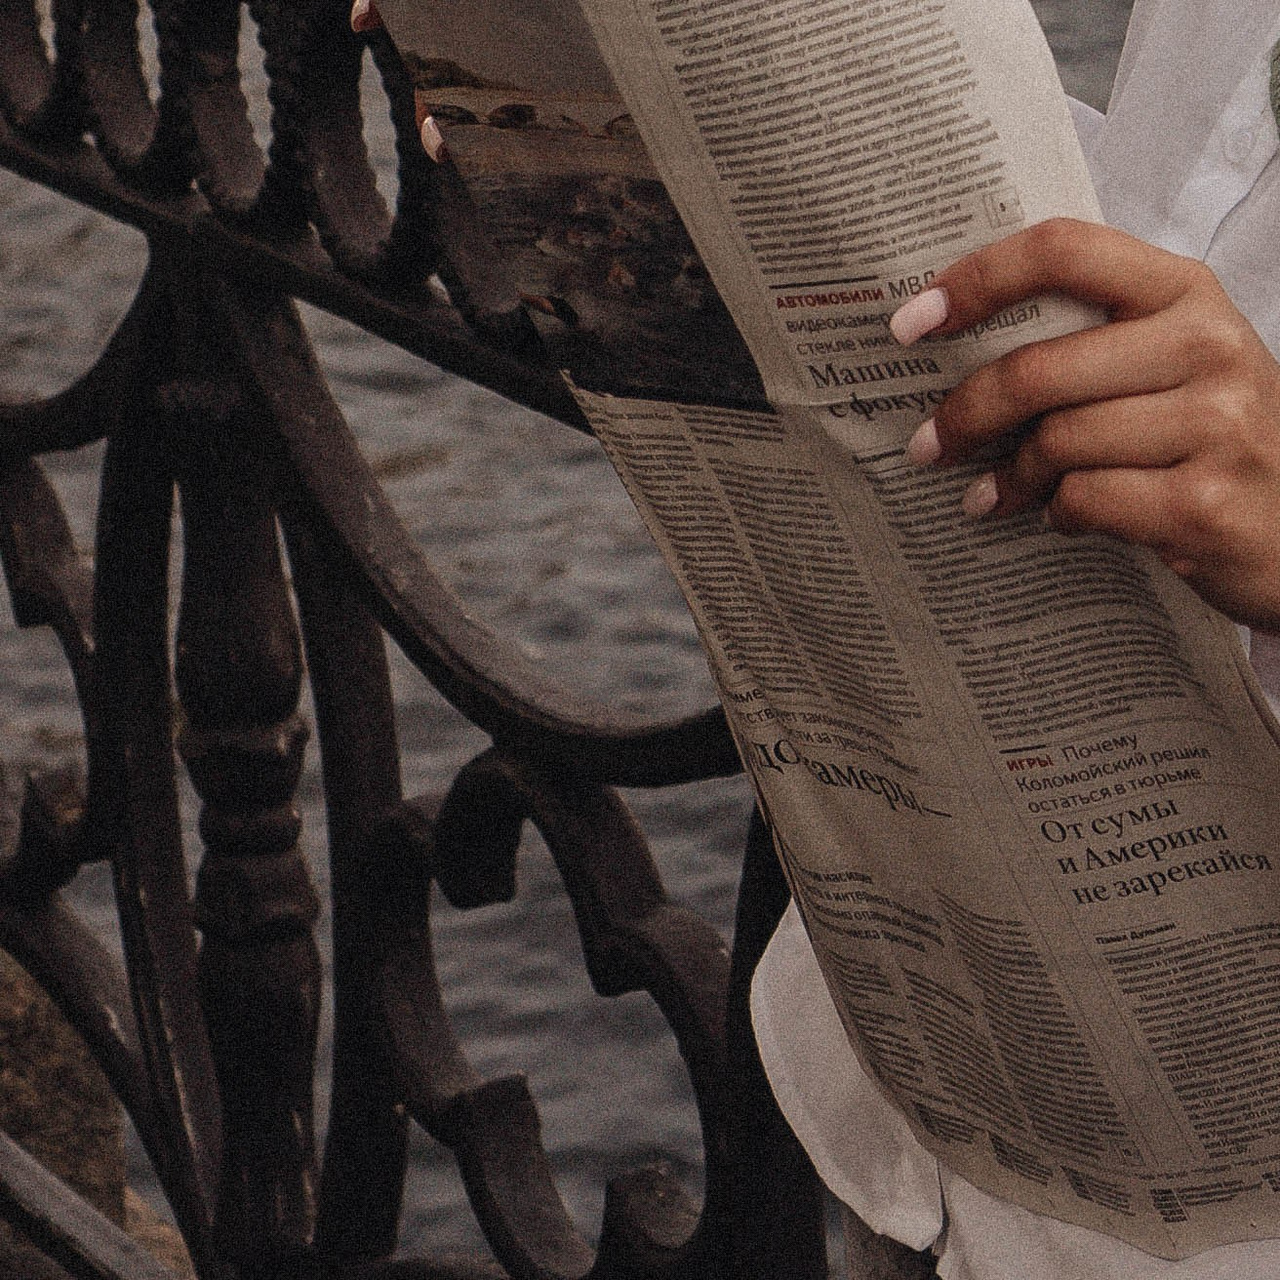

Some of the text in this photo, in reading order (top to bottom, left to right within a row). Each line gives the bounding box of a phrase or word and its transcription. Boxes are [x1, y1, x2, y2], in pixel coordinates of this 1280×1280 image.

[775, 287, 884, 310] АВТОМОБИЛИ
[786, 312, 894, 335] видеокамер
[796, 338, 856, 357] стекле
[807, 356, 943, 390] Машина
[1005, 734, 1138, 772] ИГРЫ Почему
[1014, 745, 1210, 794] Коломойский решил
[1027, 766, 1202, 814] остаться в тюрьме
[1040, 798, 1181, 844] От сумы
[1057, 823, 1230, 876] и Америки
[1071, 849, 1274, 906] не зарекайся
